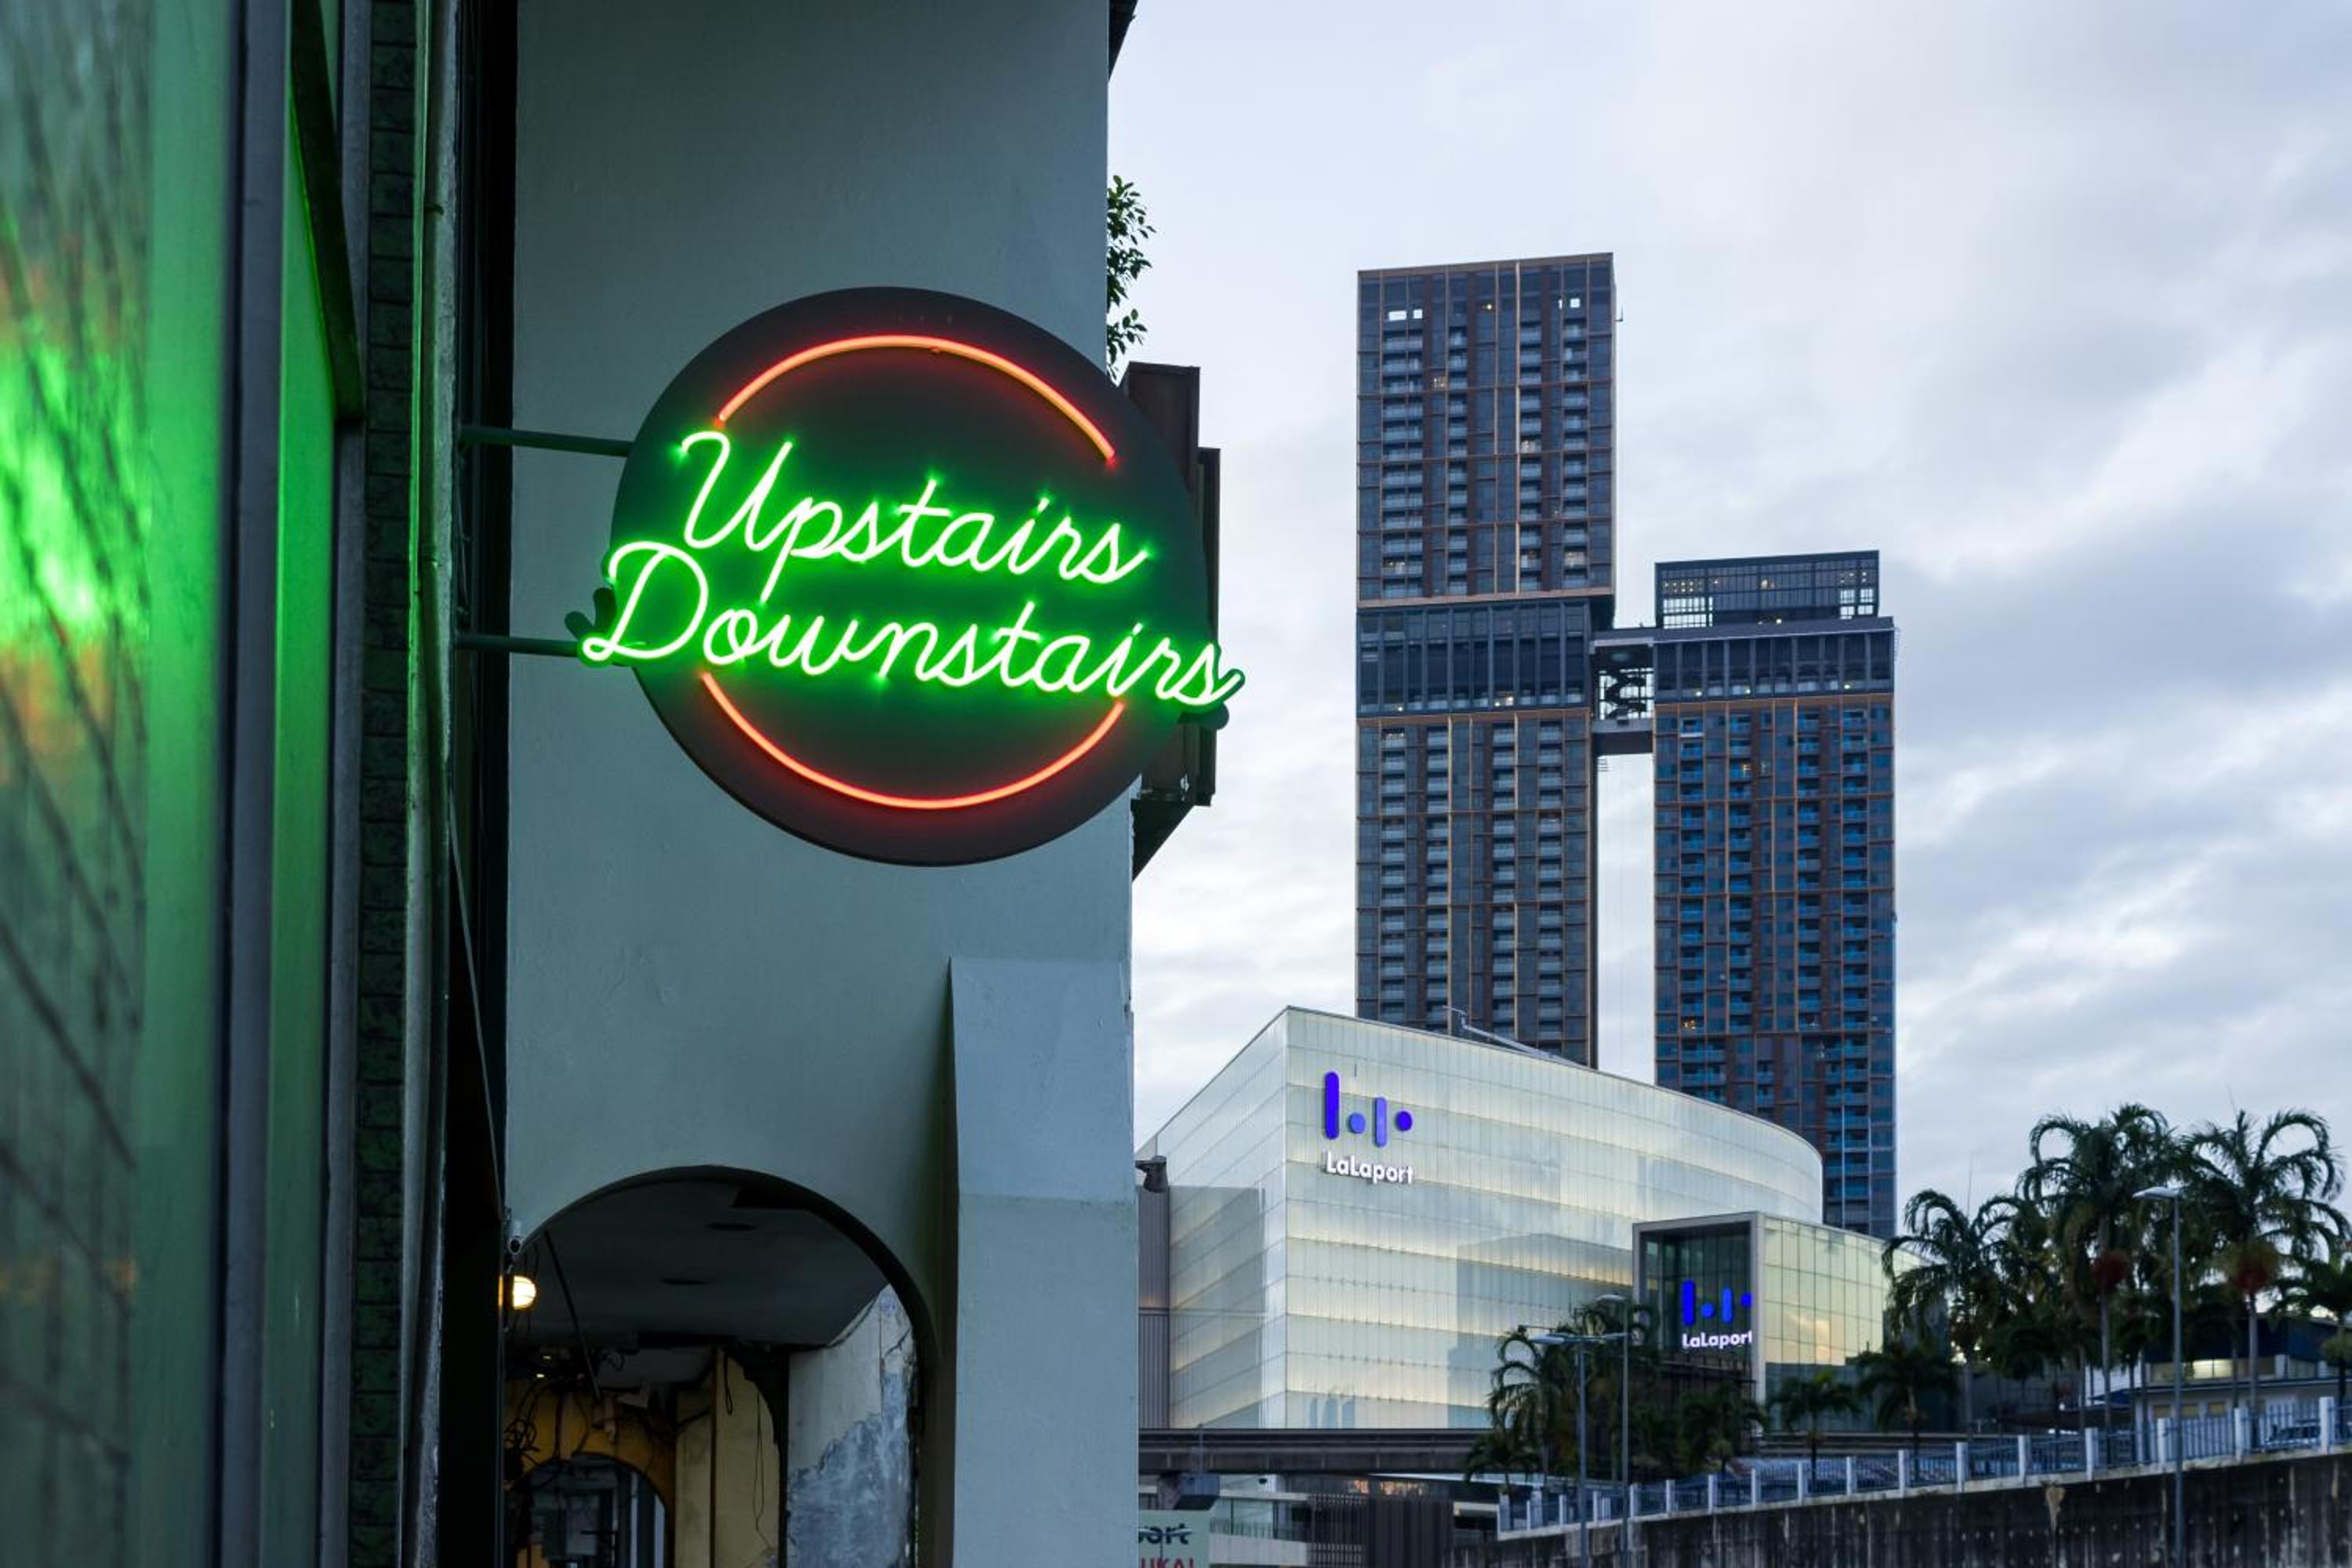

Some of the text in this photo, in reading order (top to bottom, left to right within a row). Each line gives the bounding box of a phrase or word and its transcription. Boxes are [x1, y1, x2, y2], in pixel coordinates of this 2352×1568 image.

[677, 430, 1152, 604] Upstairs
[583, 540, 1244, 706] Downstairs
[1326, 1150, 1414, 1185] LaLaport
[1682, 1330, 1752, 1349] LaLaport
